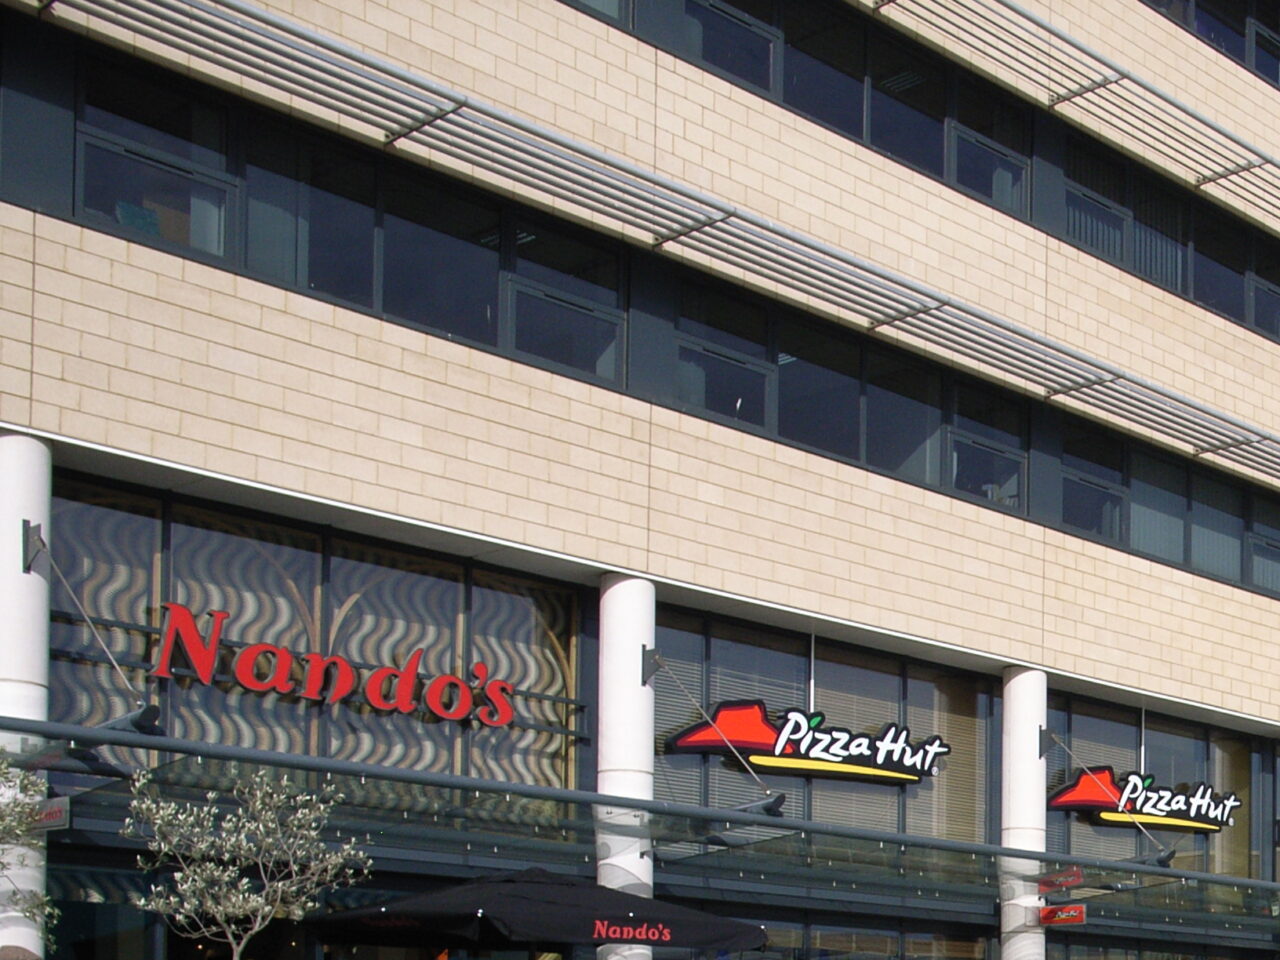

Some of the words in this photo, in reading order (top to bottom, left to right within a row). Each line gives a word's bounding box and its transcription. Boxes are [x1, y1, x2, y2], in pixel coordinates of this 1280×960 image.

[150, 602, 514, 727] Nando's
[775, 712, 871, 762] Pizza
[876, 727, 949, 771] Hut
[1118, 774, 1187, 816] Pizza
[1189, 785, 1241, 822] Hut
[593, 920, 671, 941] Nando's
